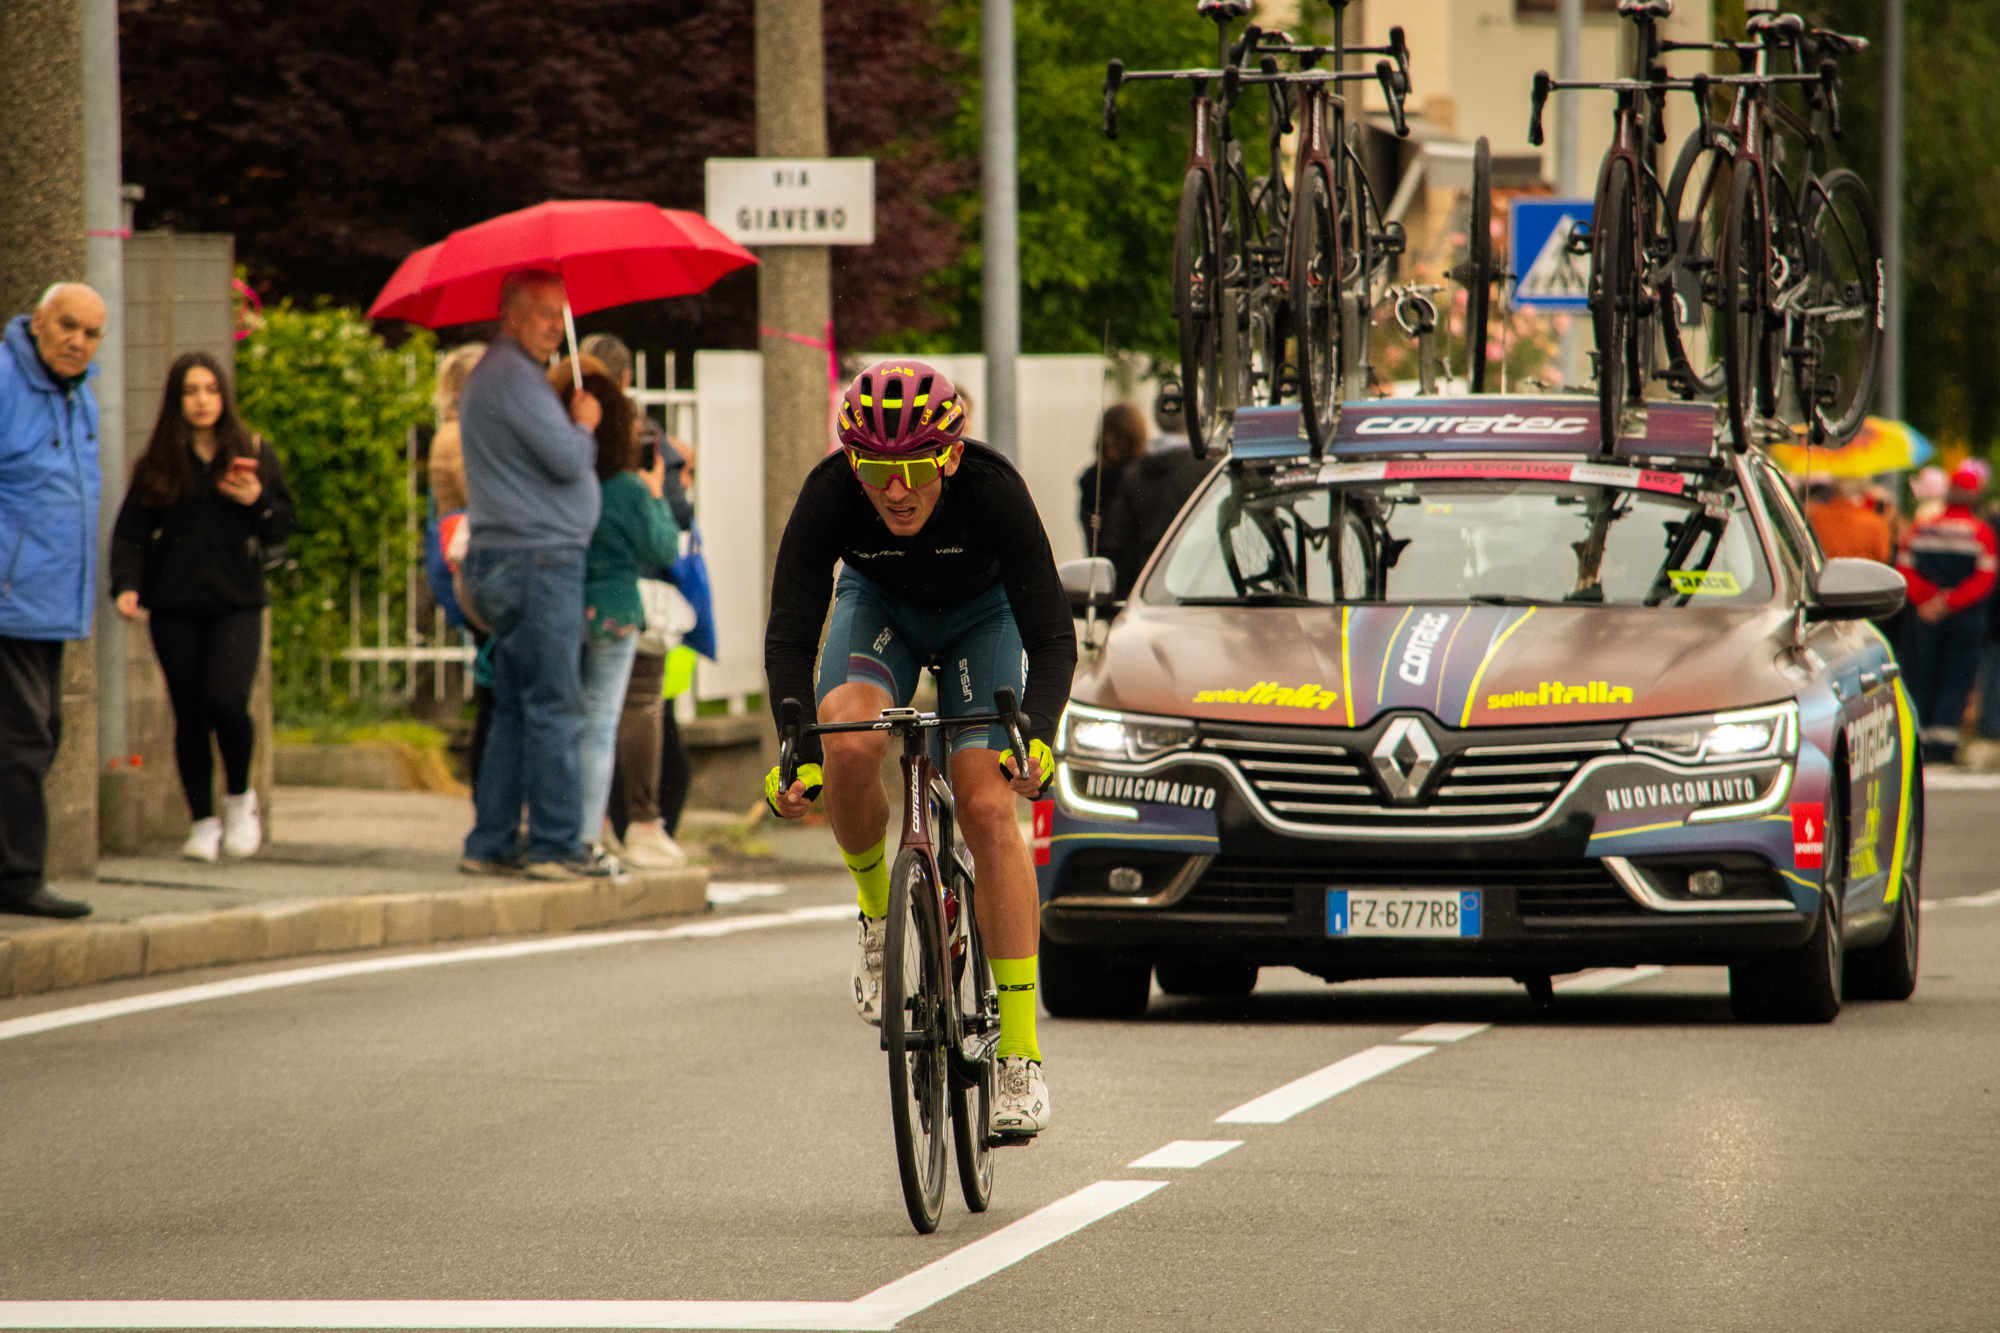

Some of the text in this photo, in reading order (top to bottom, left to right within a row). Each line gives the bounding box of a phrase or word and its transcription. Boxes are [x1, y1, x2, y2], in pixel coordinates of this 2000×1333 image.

[773, 169, 809, 187] VIA
[737, 207, 848, 231] GIAVENO
[880, 366, 915, 377] LAS
[855, 409, 863, 428] LAS
[921, 408, 933, 426] LAS
[1355, 413, 1589, 434] corratec
[1388, 462, 1468, 473] GRUPPO
[1472, 462, 1568, 474] SPORTIVO
[1399, 612, 1450, 686] corratec
[959, 658, 972, 702] URSUS
[911, 764, 920, 833] corratec
[1086, 775, 1216, 810] NUOVACOMAUTO
[1606, 778, 1755, 811] NUOVACOMAUTO
